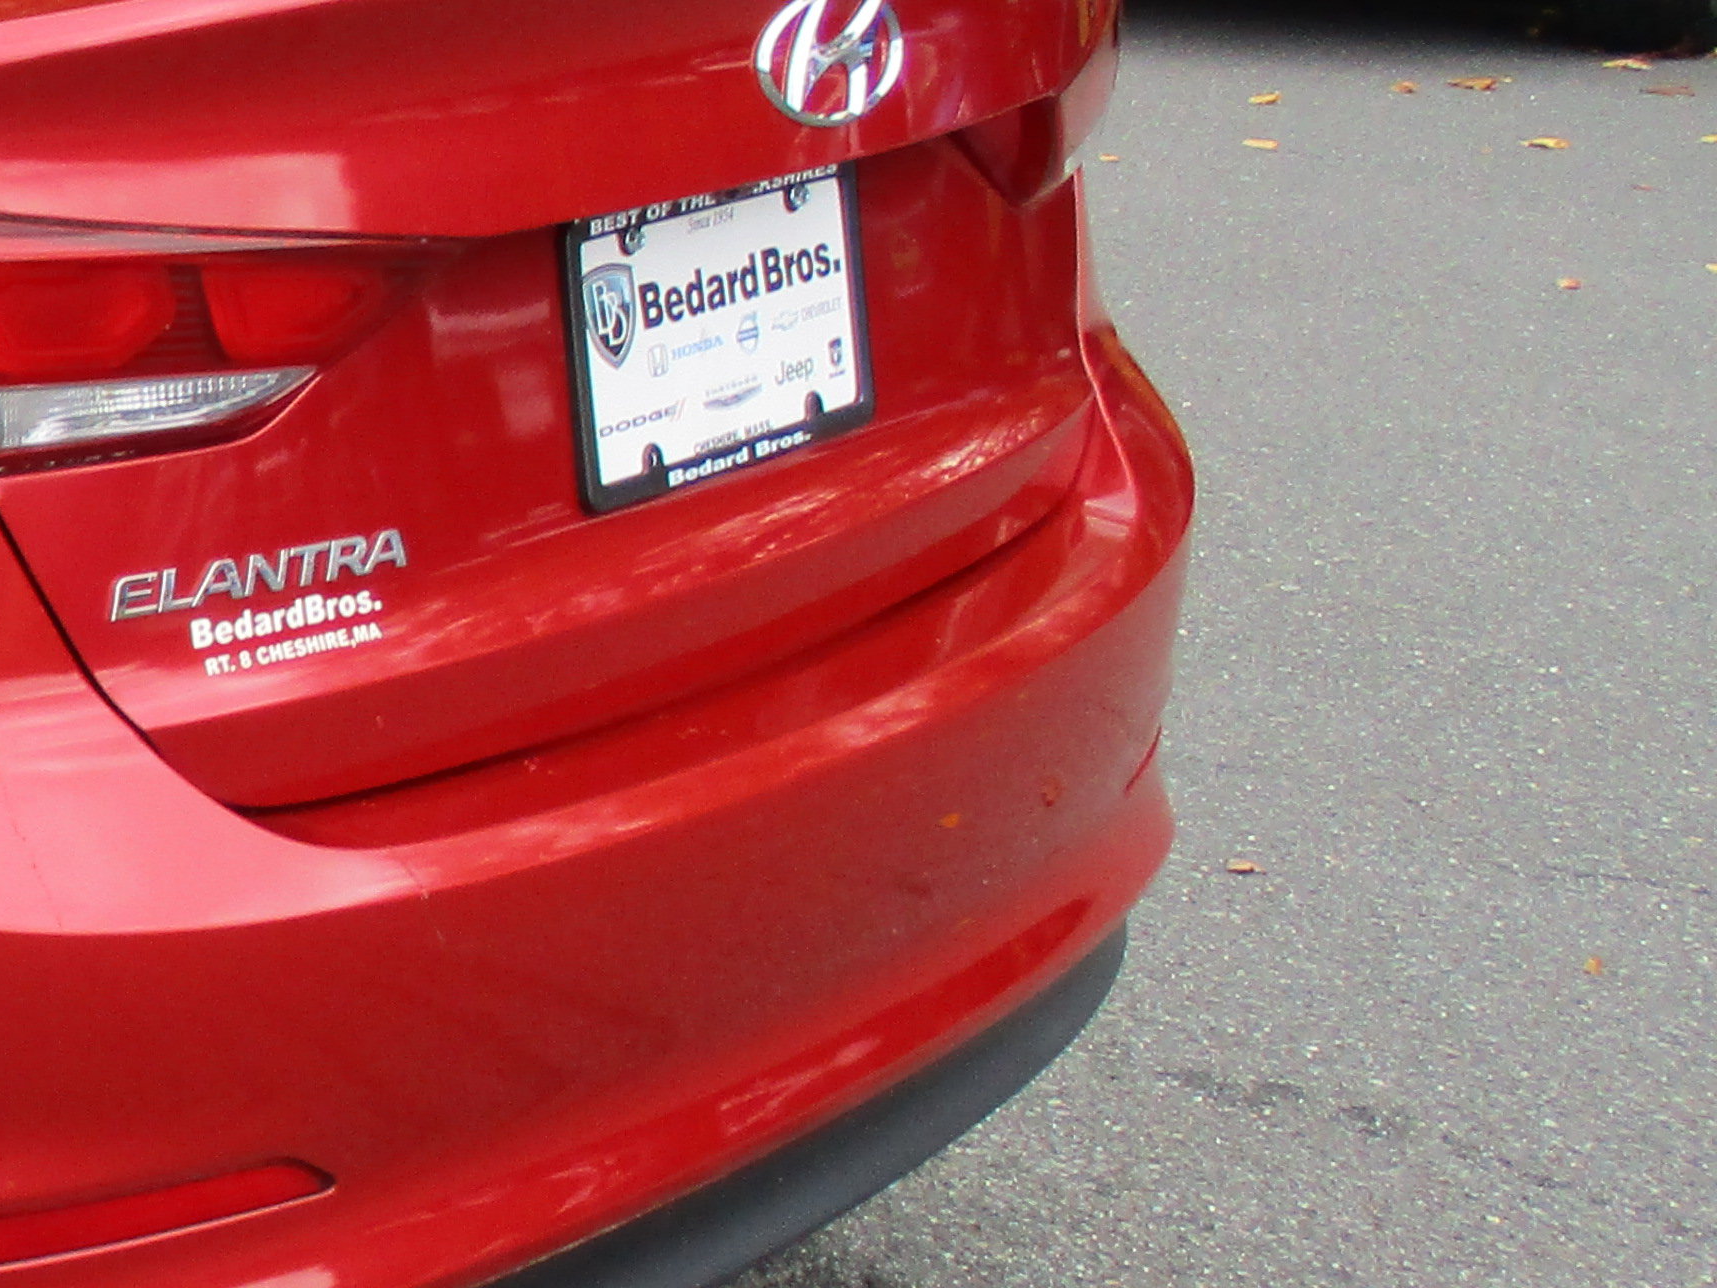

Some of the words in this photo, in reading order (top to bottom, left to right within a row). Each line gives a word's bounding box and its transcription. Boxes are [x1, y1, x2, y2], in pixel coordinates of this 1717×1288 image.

[590, 212, 640, 236] BEST
[672, 335, 724, 360] HONDA
[775, 357, 814, 385] Jeep
[599, 404, 679, 439] DODGE
[668, 447, 749, 488] Bedard
[755, 431, 812, 458] Bros.
[111, 528, 408, 623] ELANTRA
[204, 655, 237, 677] RT.
[239, 649, 254, 669] 8
